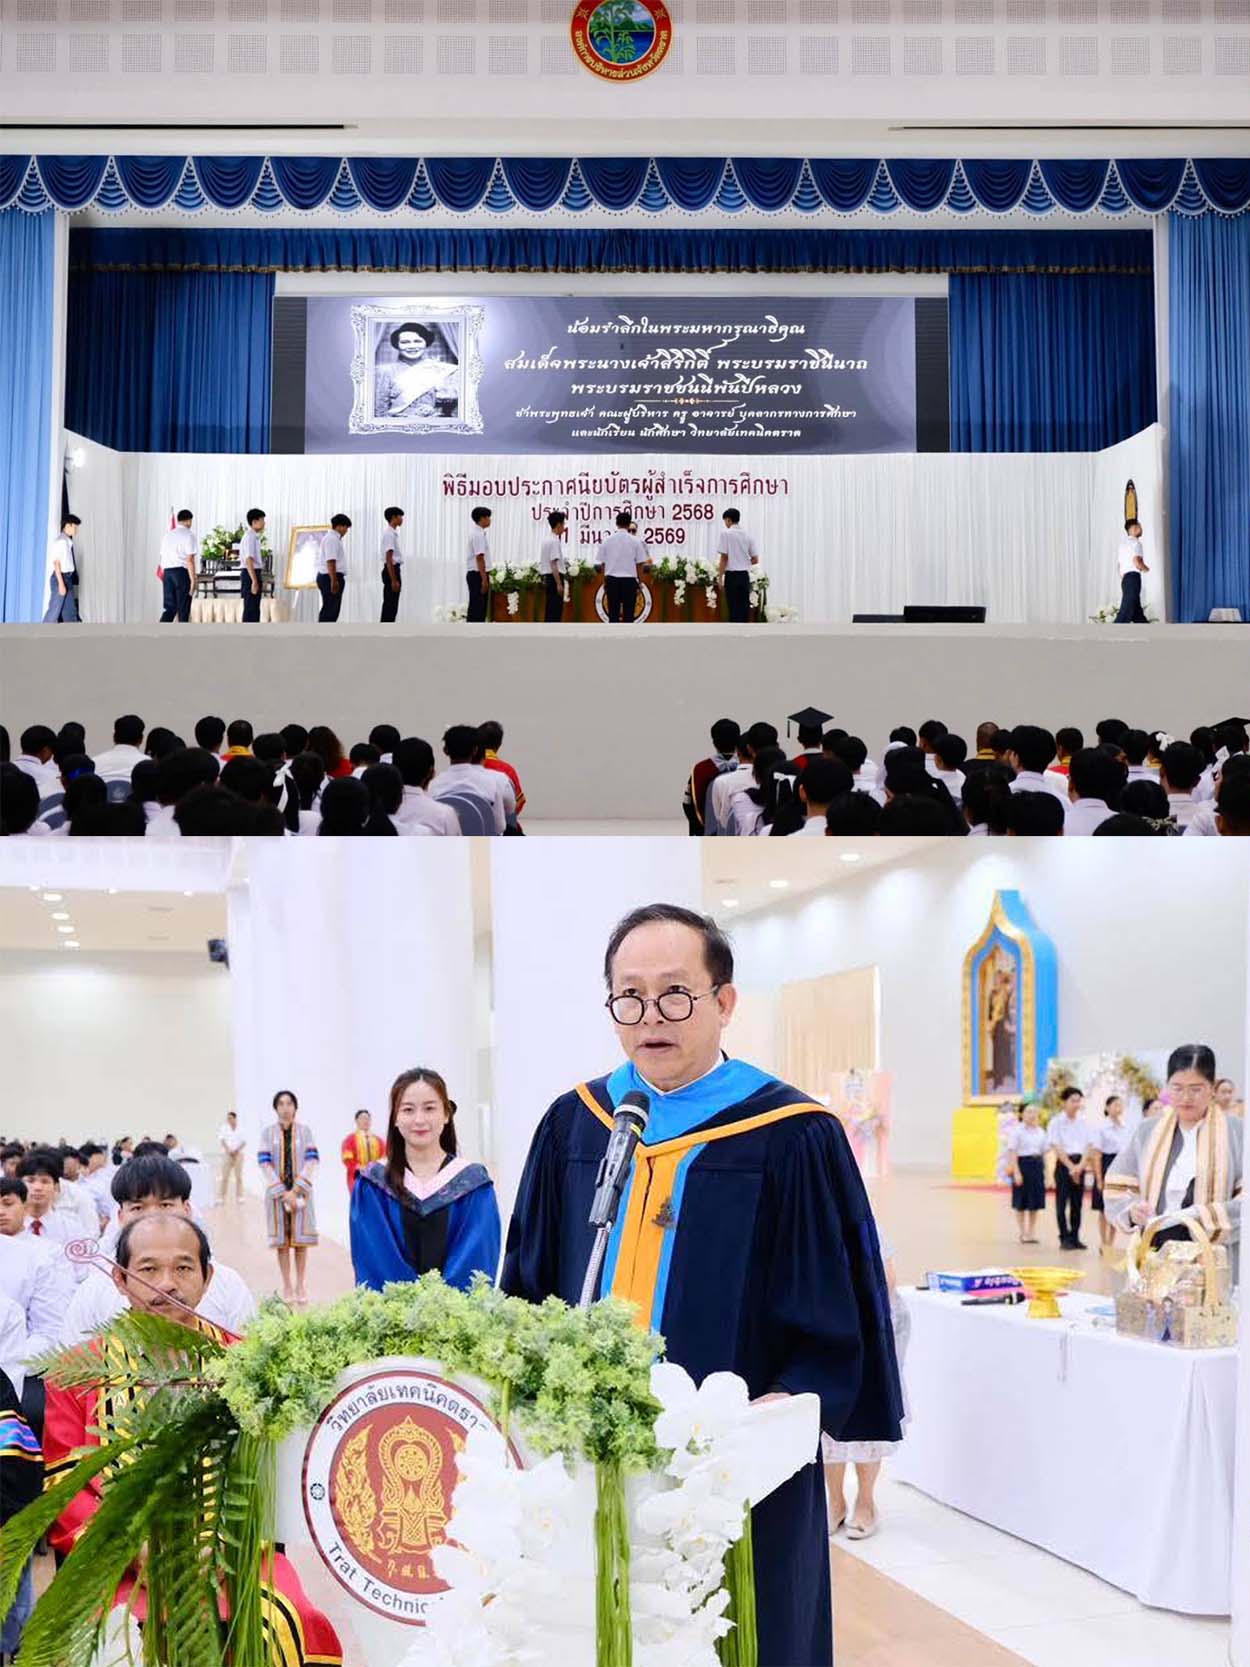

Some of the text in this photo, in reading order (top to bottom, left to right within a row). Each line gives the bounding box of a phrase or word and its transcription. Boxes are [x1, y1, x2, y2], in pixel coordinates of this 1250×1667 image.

[567, 315, 805, 342] น้อมรำลึกในพระมหากรุณาธิคุณ
[717, 348, 868, 370] พระบรมราชินีนาถ
[570, 373, 802, 395] พระบรมราชชนนีพันปีหลวง
[443, 470, 788, 500] พิธีมอบประกาศนียบัตรผู้สำเร็จการศึกษา
[672, 504, 714, 520] 2568
[644, 528, 686, 544] 2569
[326, 1382, 488, 1433] วิทยาลัยเทคนิคตรา
[327, 1541, 429, 1614] Trat Technic
